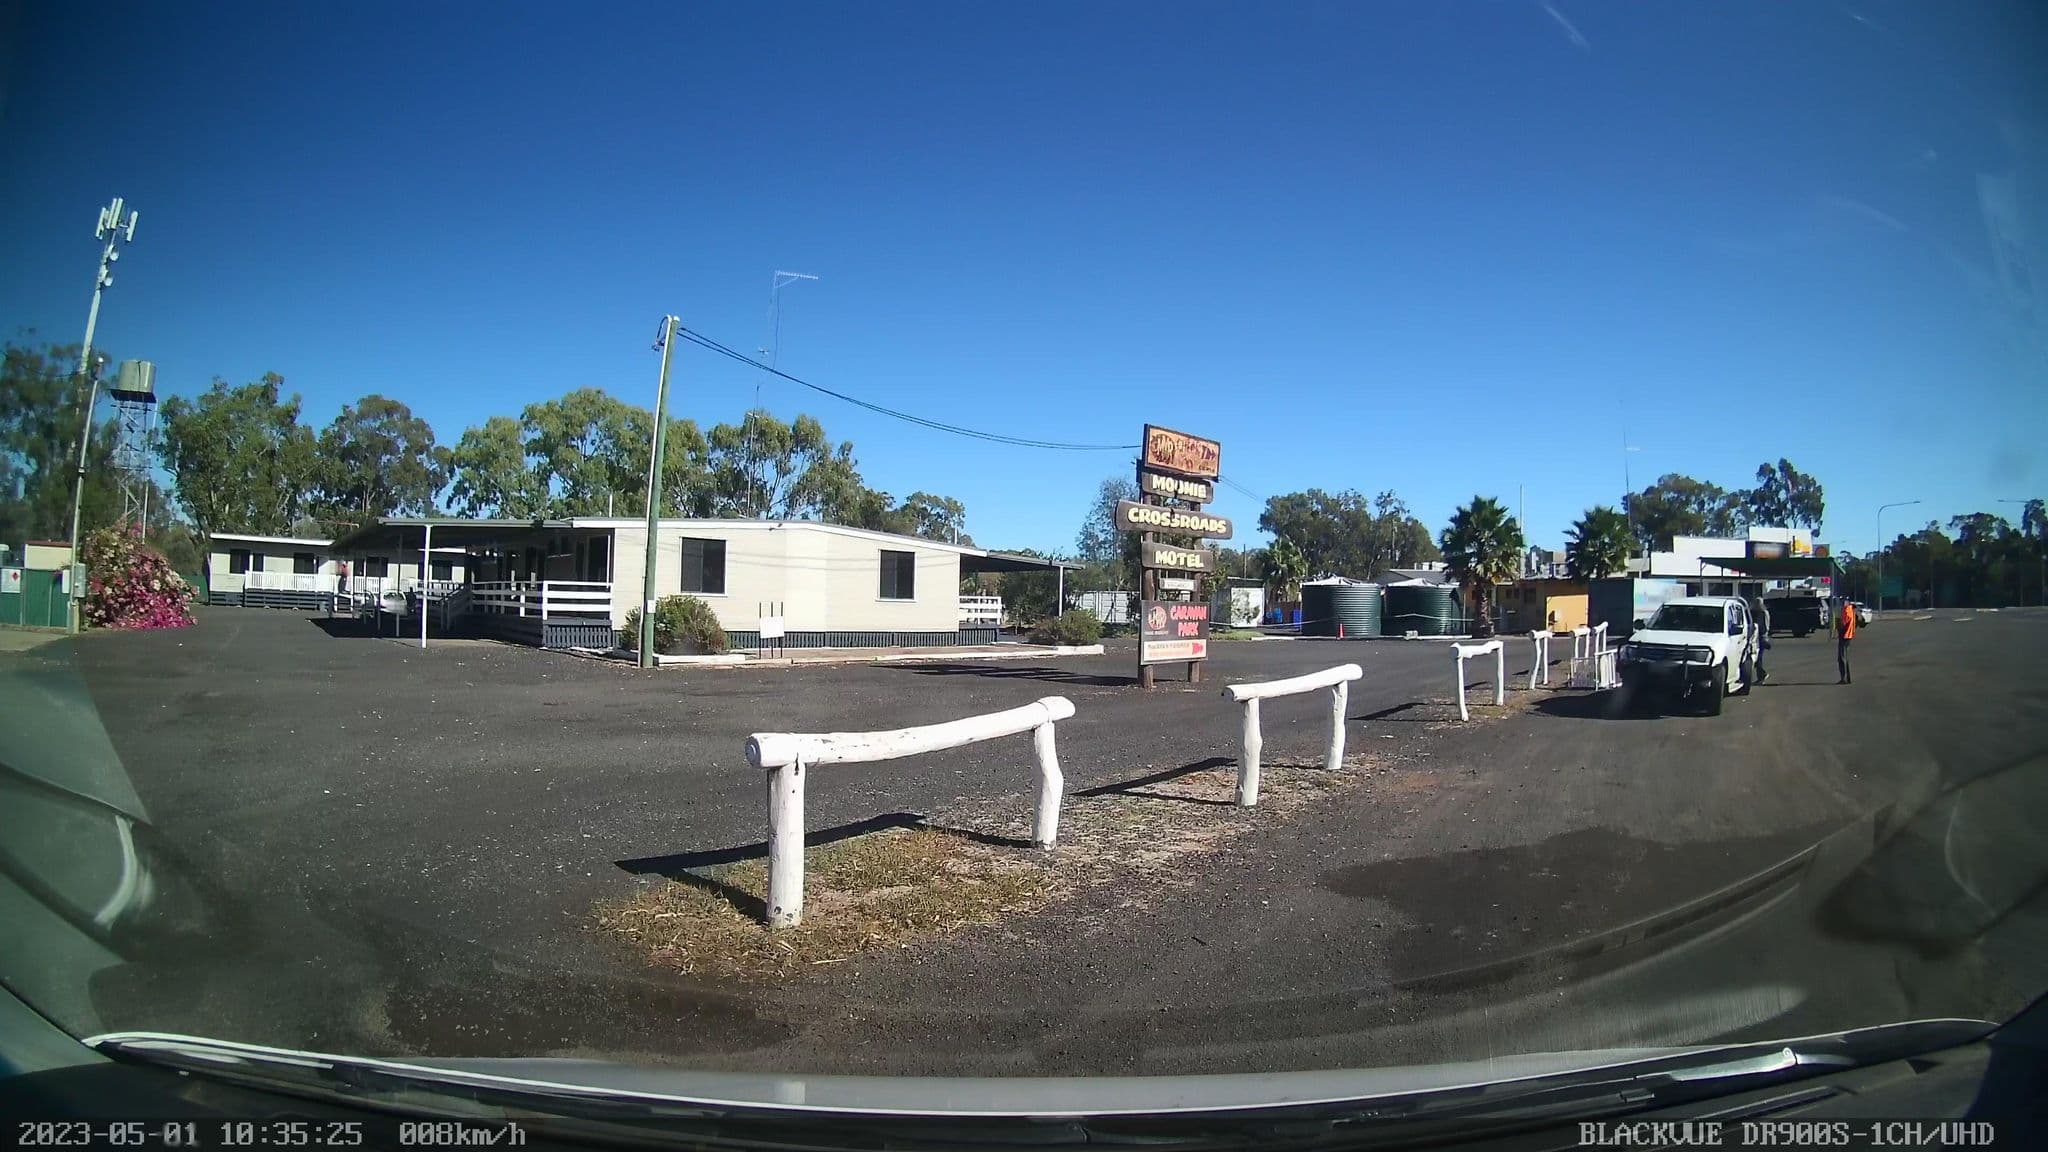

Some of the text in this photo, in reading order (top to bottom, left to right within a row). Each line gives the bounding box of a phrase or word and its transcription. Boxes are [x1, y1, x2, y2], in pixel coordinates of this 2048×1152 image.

[1128, 507, 1227, 534] CROSSROADS
[1155, 551, 1204, 568] MOTEL
[1170, 605, 1207, 620] CARAVAN
[1178, 622, 1199, 637] PARK
